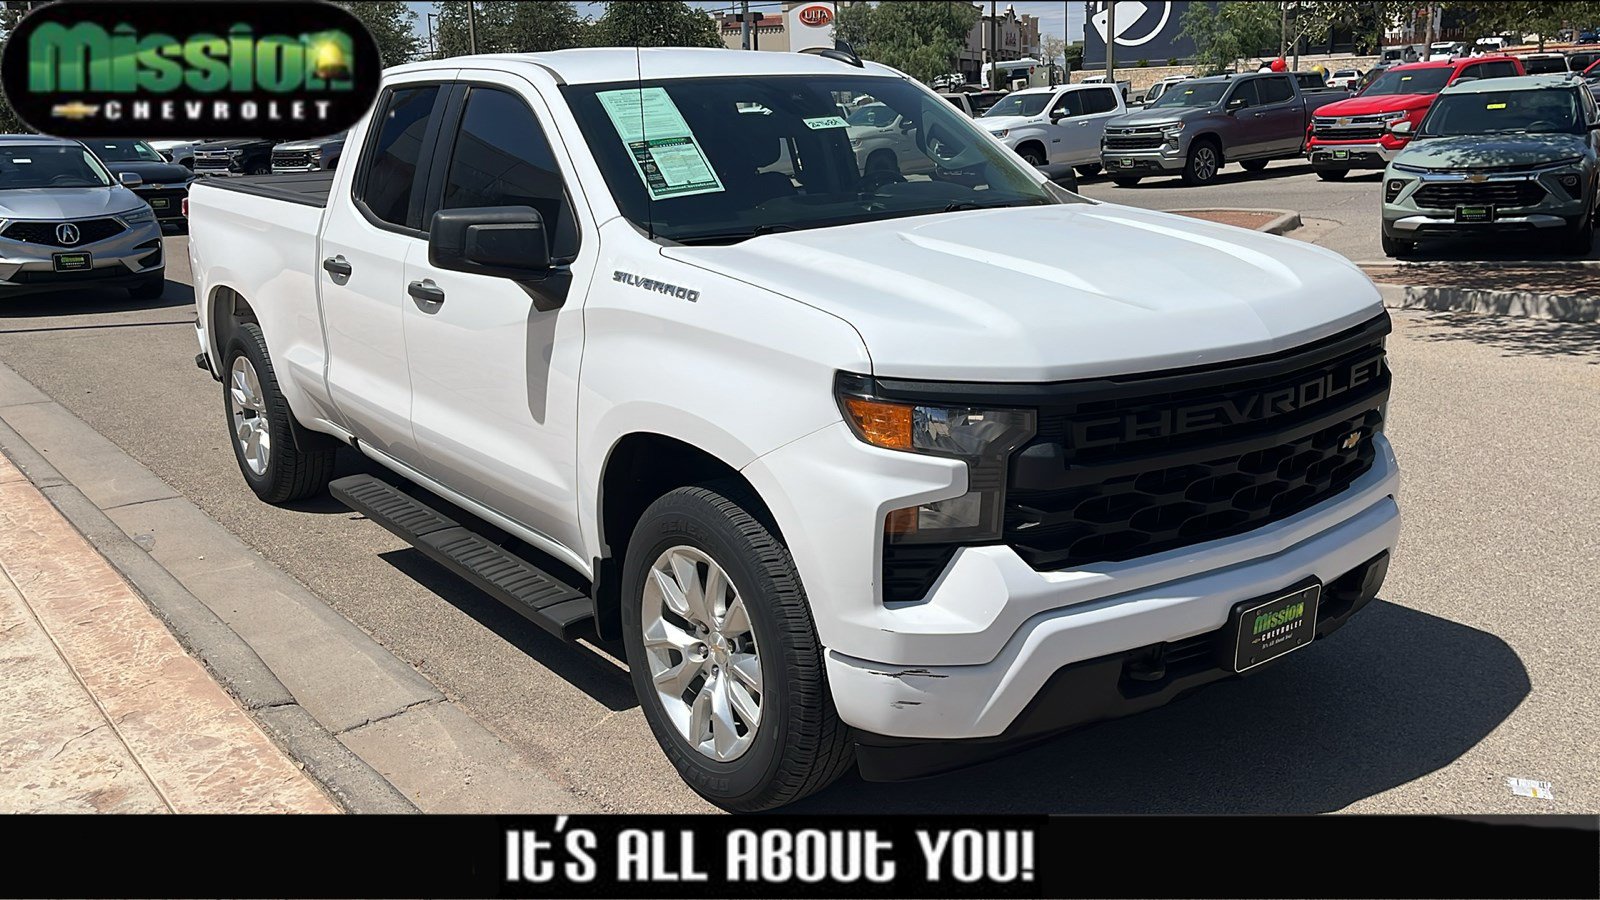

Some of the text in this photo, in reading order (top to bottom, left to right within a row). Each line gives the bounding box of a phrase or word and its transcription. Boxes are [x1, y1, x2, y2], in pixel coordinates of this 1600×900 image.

[804, 9, 829, 20] ULTA
[612, 270, 701, 303] SILVERADO
[1073, 354, 1387, 448] CHEVROLET
[1253, 602, 1304, 635] Mission
[1261, 619, 1303, 642] CHEVROLET
